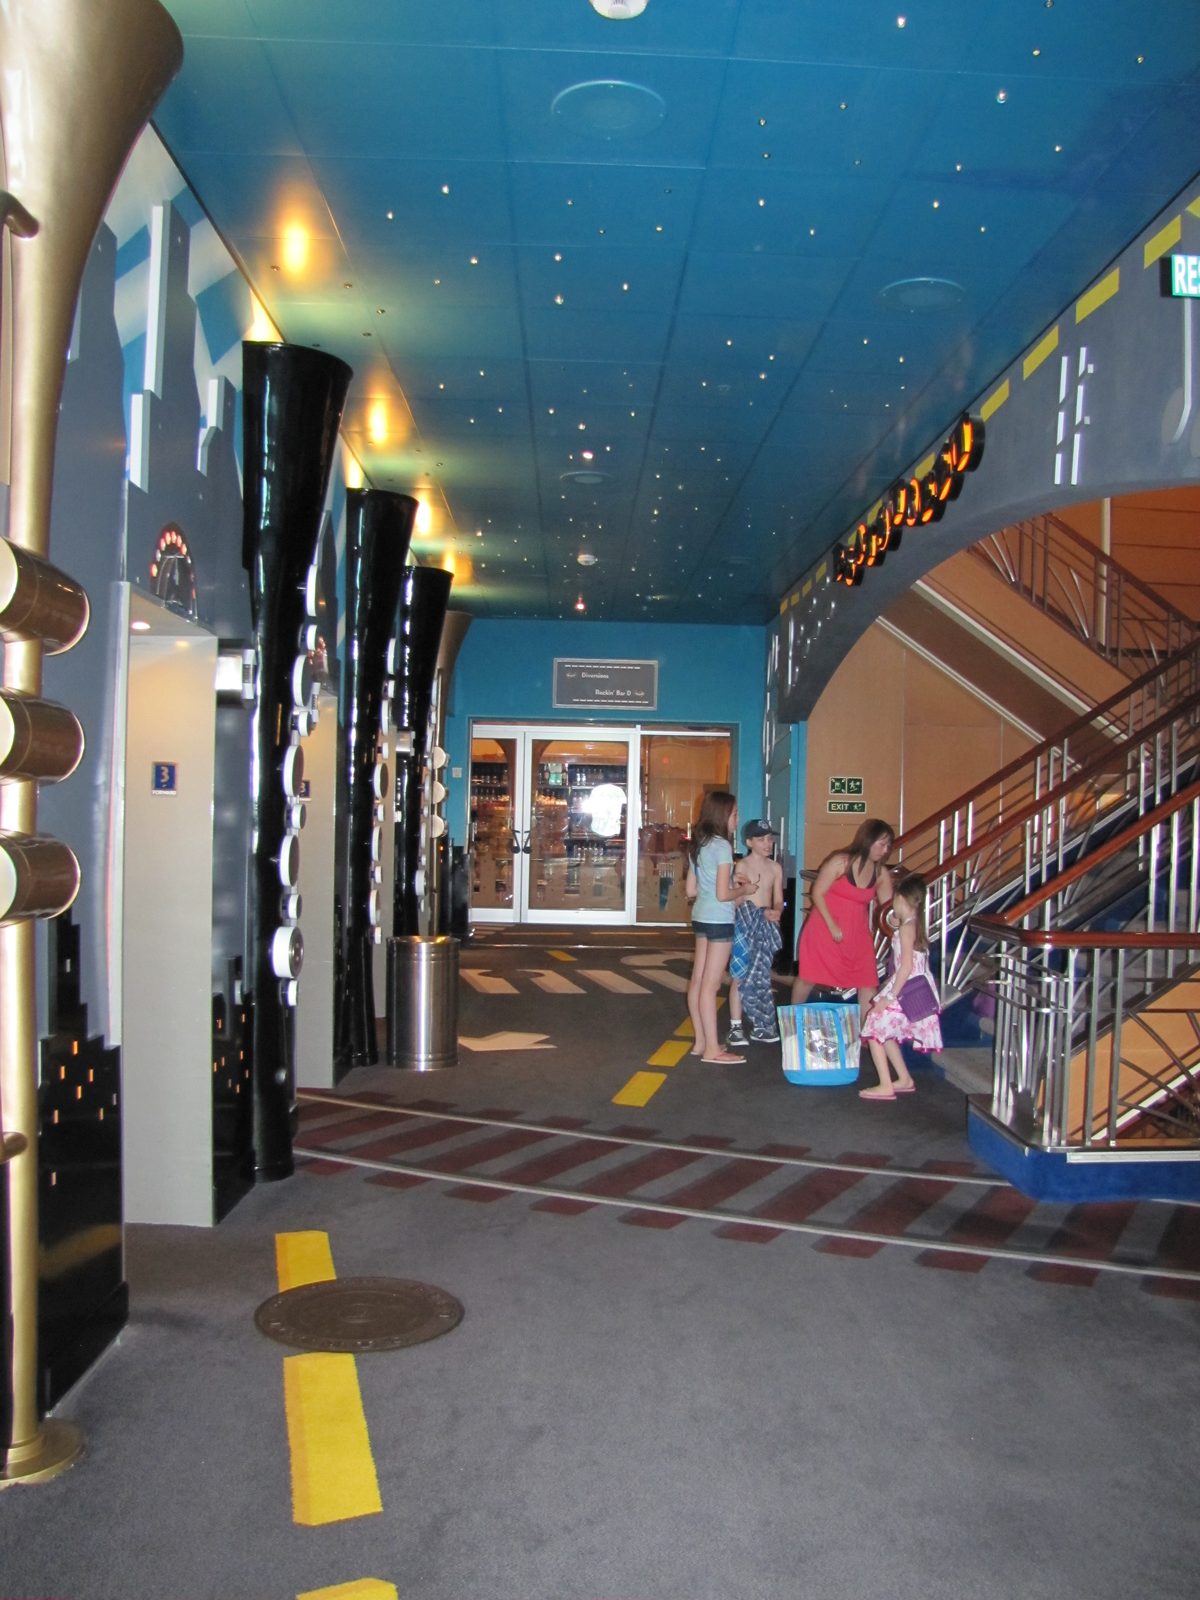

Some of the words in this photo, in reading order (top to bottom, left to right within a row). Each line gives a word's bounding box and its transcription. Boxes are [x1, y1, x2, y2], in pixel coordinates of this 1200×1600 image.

[1174, 255, 1200, 294] RE
[581, 671, 609, 679] Diversions
[616, 689, 626, 697] Bar
[160, 766, 170, 783] 3
[831, 803, 849, 811] EXIT
